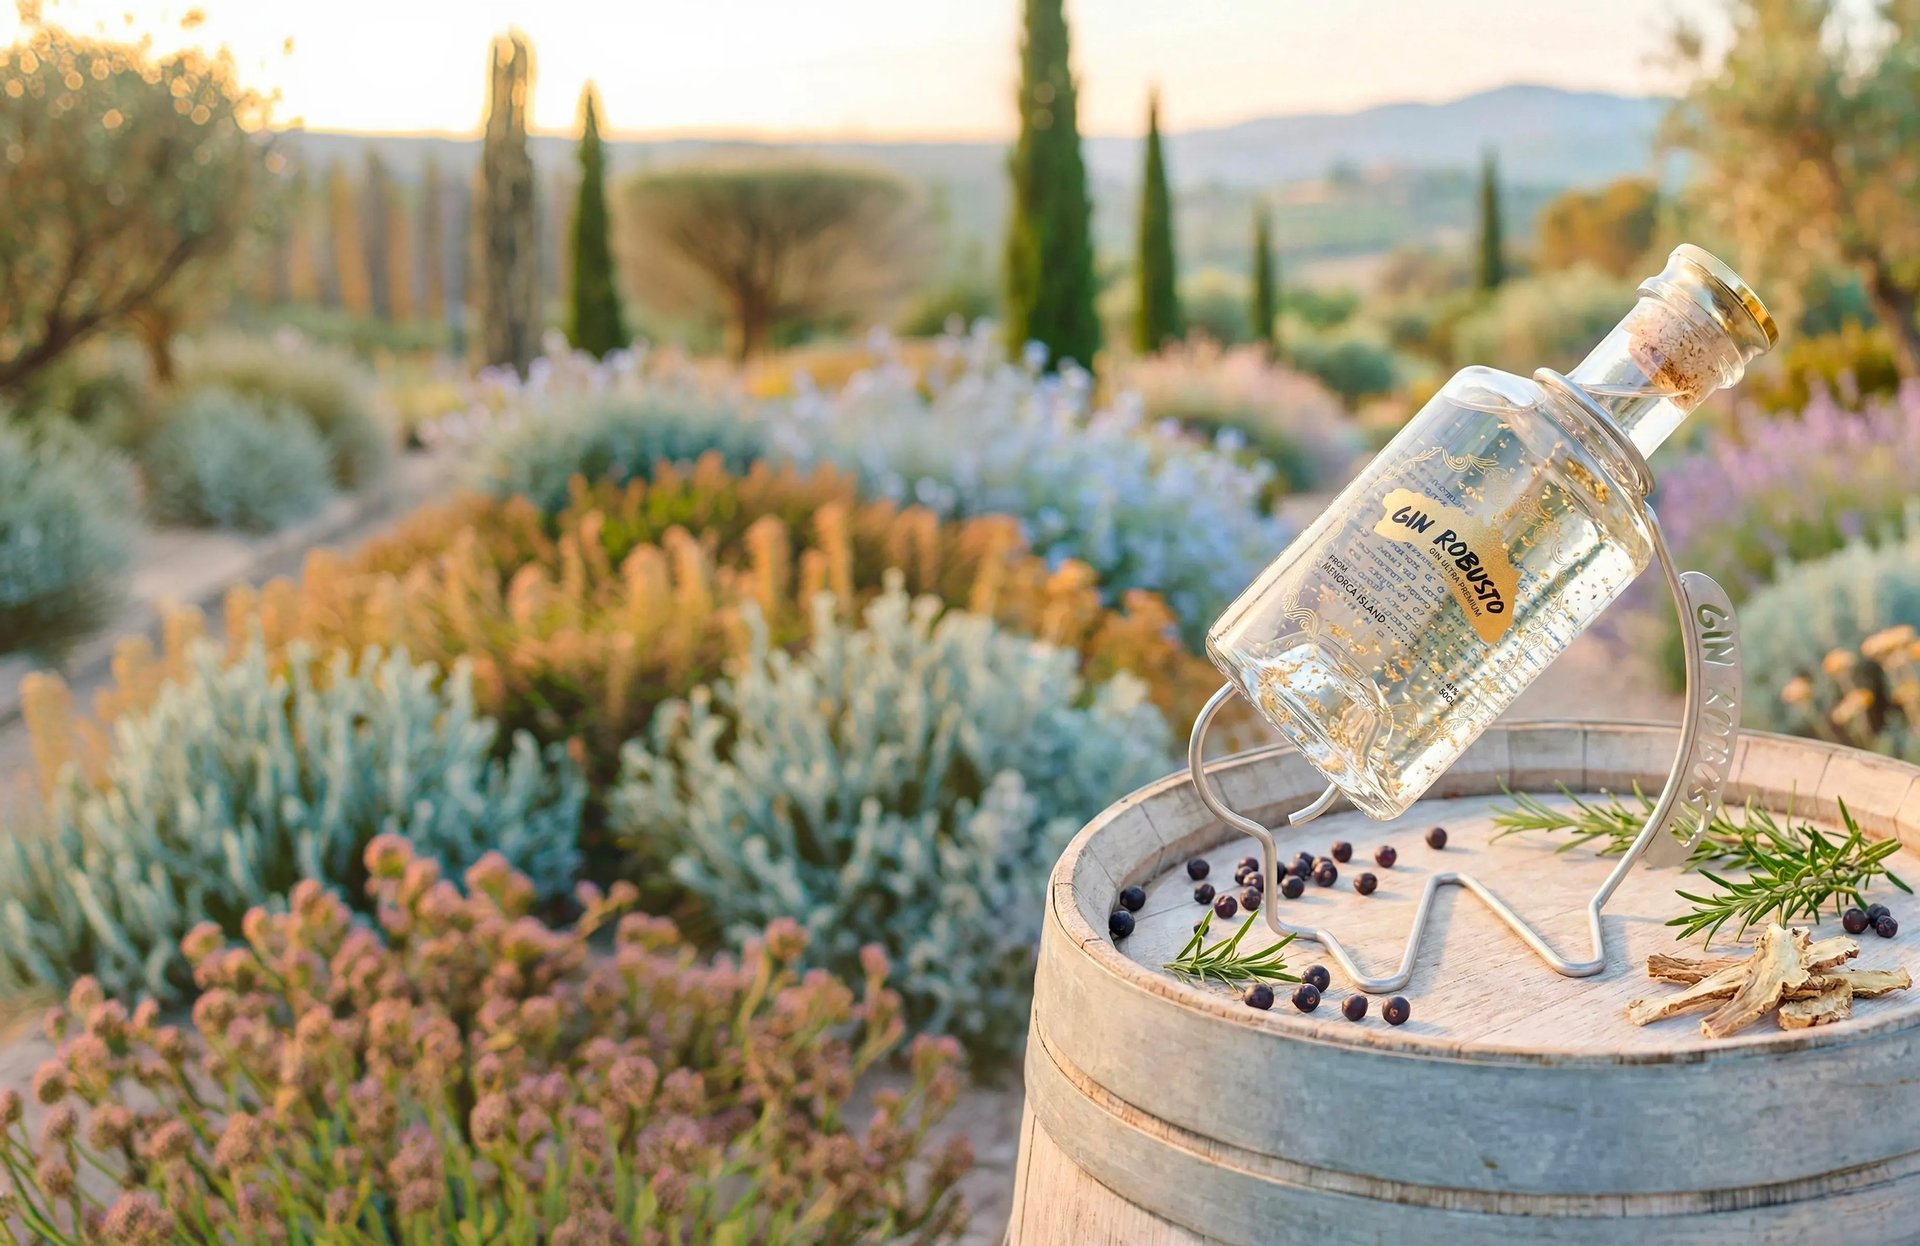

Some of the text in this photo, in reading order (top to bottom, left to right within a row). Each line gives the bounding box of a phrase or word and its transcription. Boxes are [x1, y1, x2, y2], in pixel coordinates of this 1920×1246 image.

[1328, 554, 1348, 573] FROM
[1391, 505, 1505, 615] GIN ROBUSTO
[1428, 547, 1482, 618] GIN ULTRA PREMIUM
[1321, 562, 1386, 623] MENORCA ISLAND
[1696, 603, 1735, 668] GIN
[1438, 688, 1455, 707] 50CL
[1445, 683, 1459, 696] 41%
